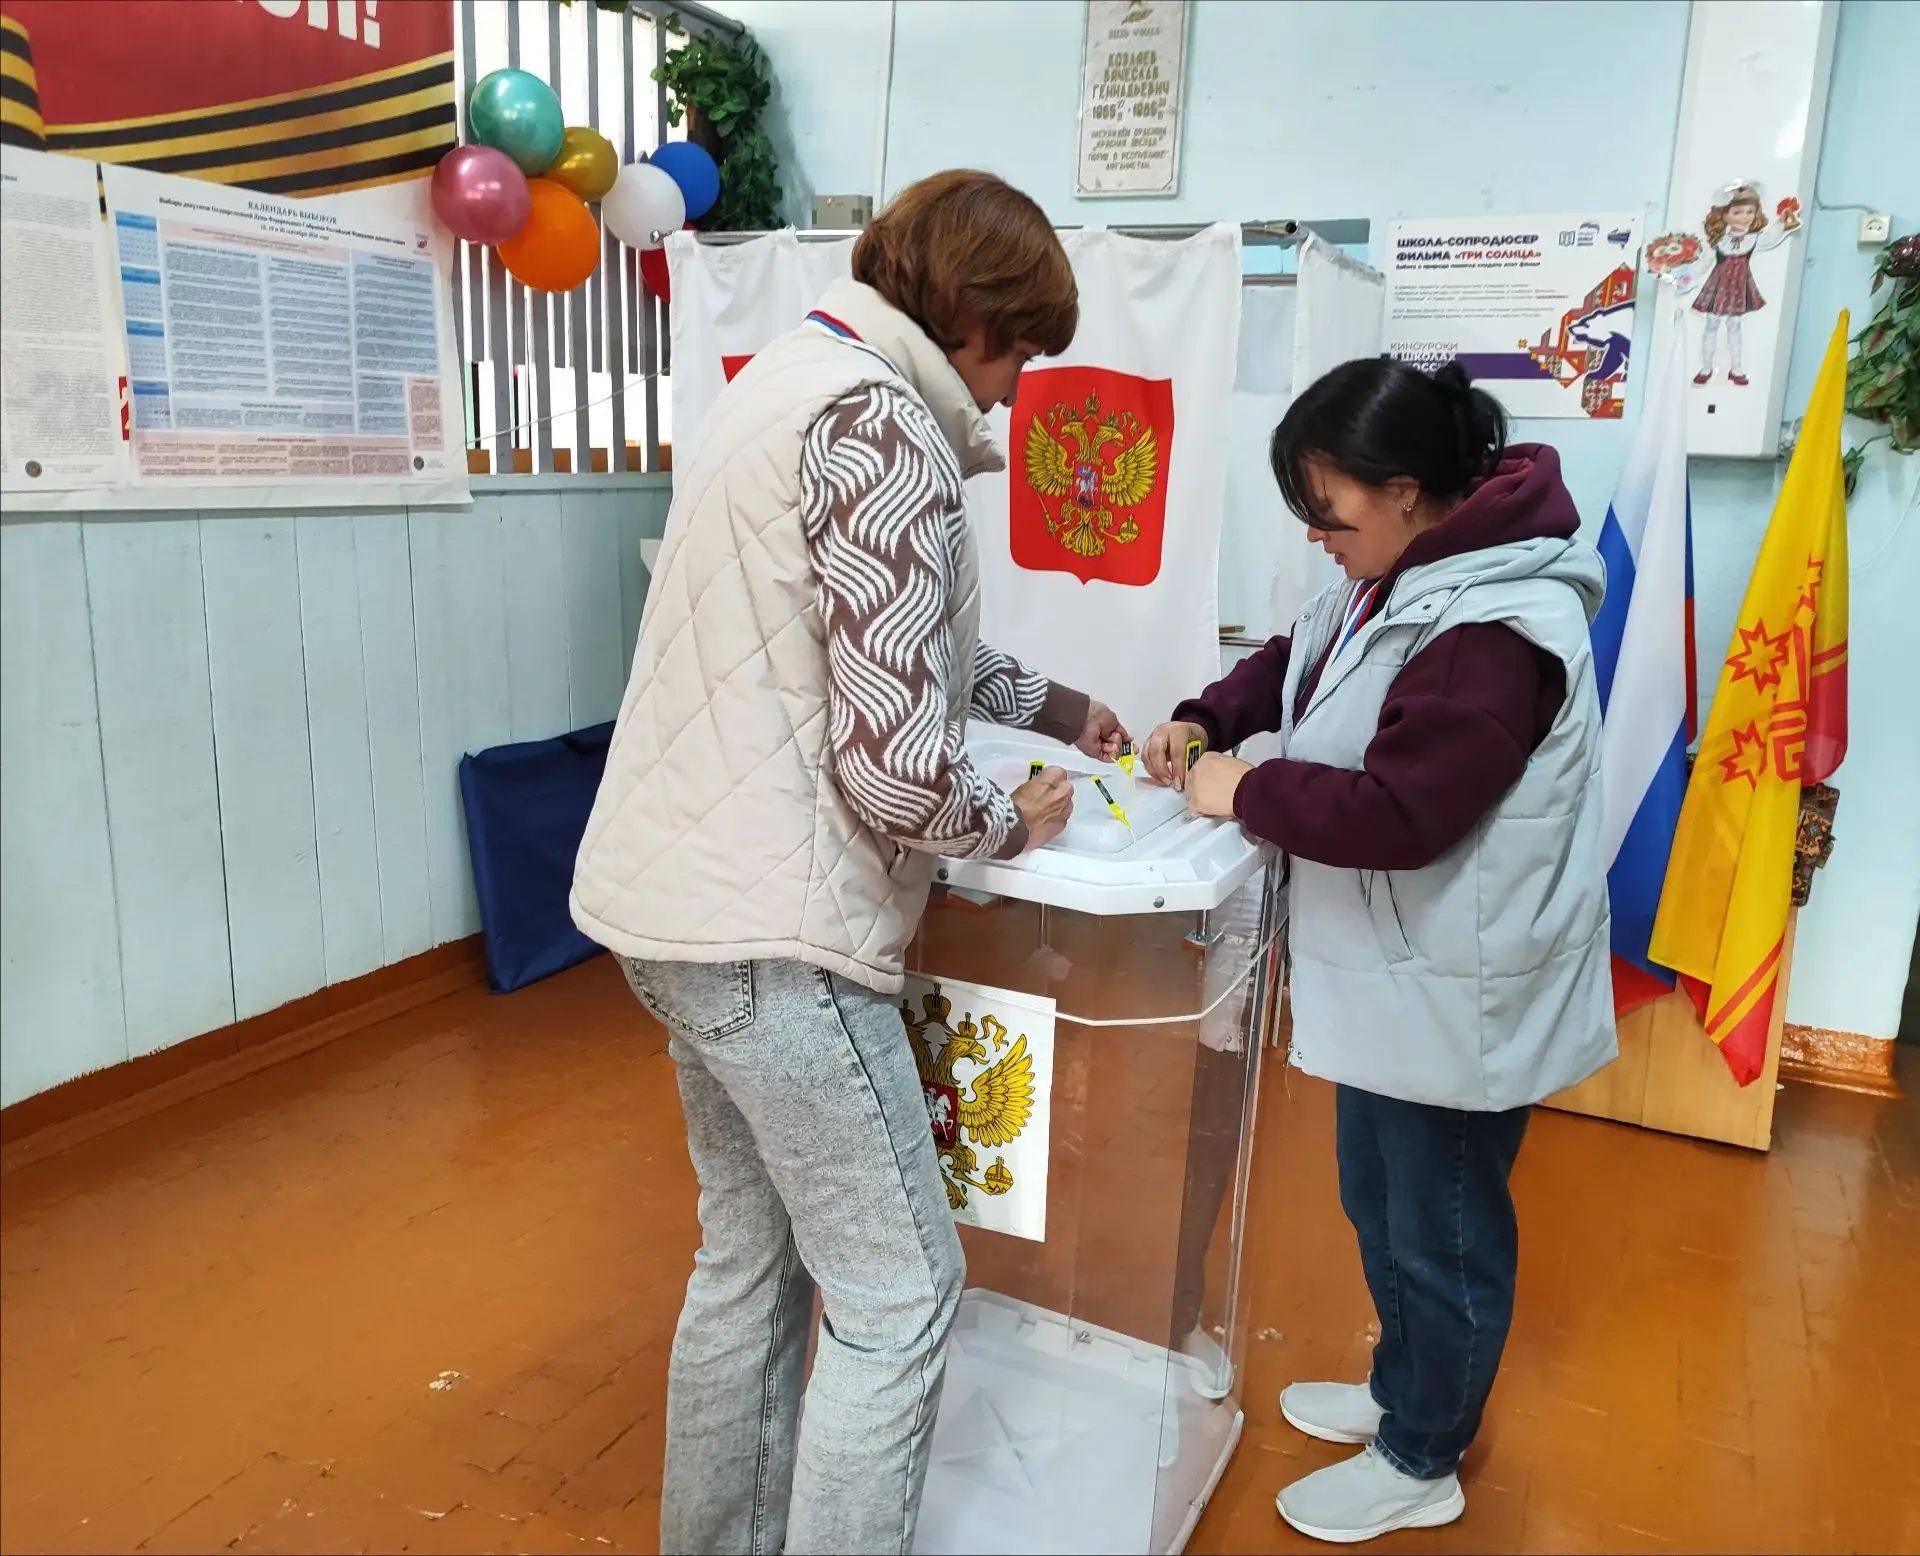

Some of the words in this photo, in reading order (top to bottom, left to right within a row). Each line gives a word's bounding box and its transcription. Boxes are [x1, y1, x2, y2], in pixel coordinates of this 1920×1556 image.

[1397, 235, 1539, 248] ШКОЛА-СОПРОДЮСЕР
[1396, 251, 1451, 261] ФИЛЬМА
[1455, 250, 1482, 260] «ТРИ
[1486, 249, 1541, 259] СОЛНЦА»
[1390, 342, 1458, 351] КИНОУРОКИ
[1401, 350, 1456, 362] ШКОЛАХ
